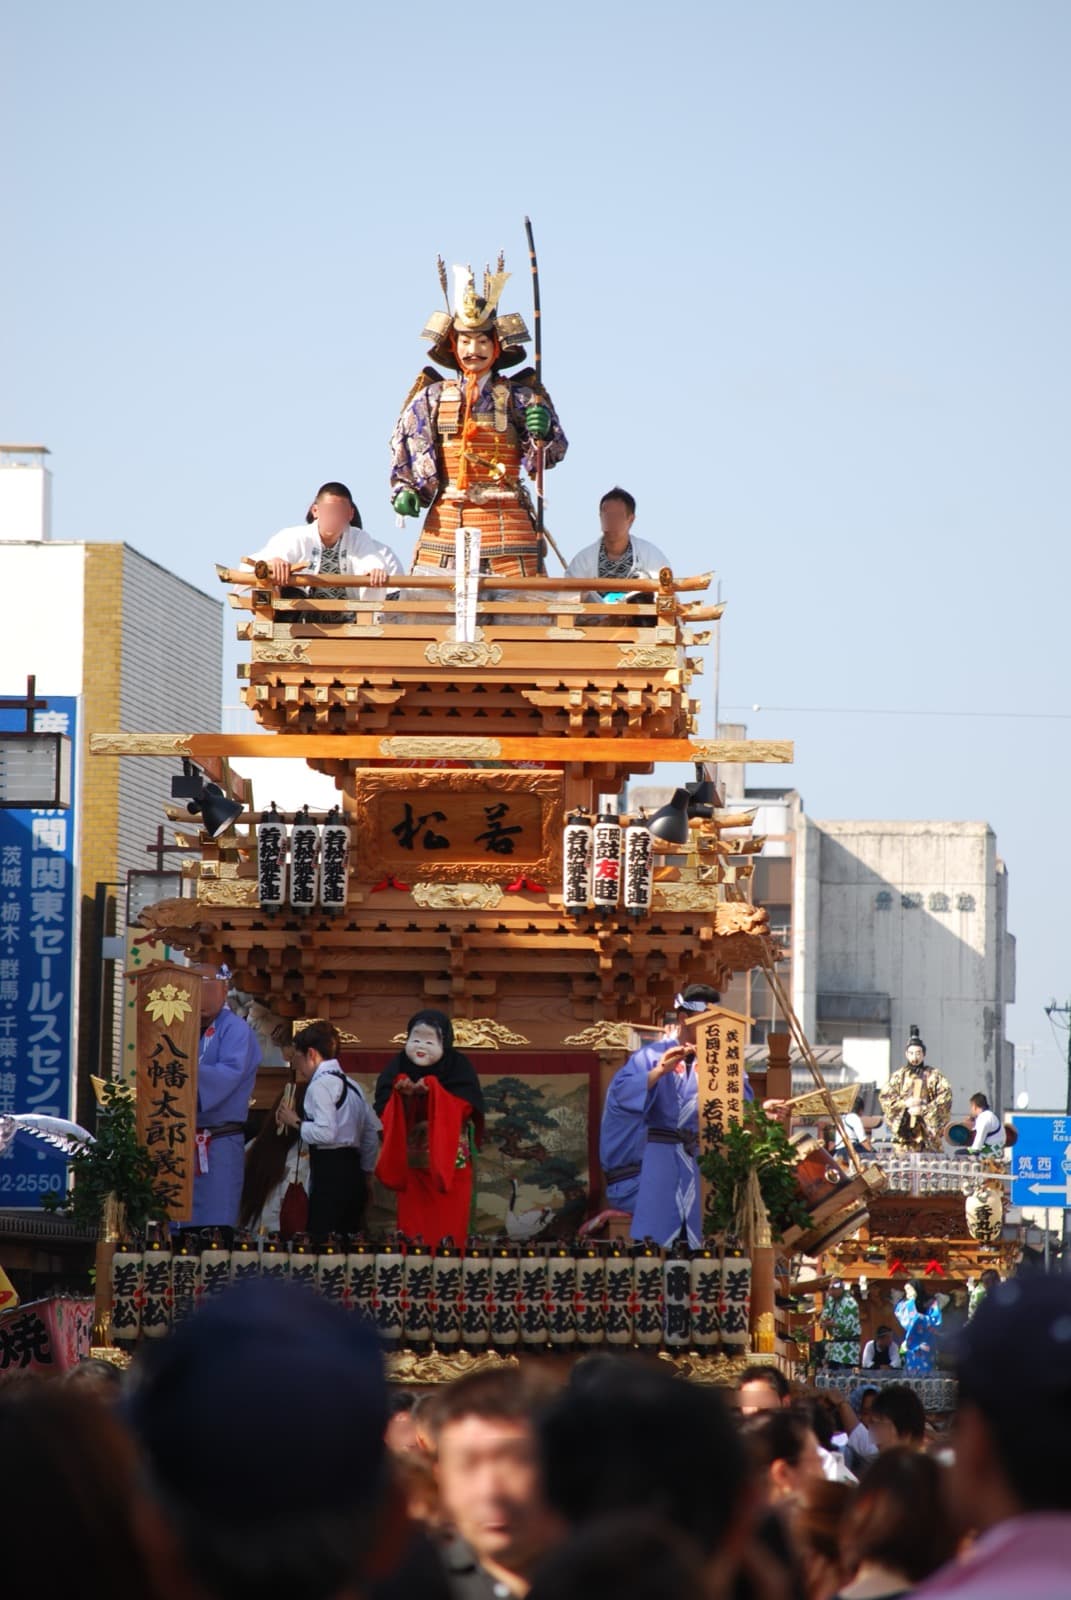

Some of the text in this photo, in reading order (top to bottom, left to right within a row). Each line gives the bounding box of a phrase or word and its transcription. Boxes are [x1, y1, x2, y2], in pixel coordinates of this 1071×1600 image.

[393, 803, 522, 855] 若松
[704, 1023, 721, 1092] 石岡はやし
[146, 1033, 189, 1209] 八幡太郎義家
[1018, 1156, 1053, 1171] 筑西
[973, 1204, 993, 1241] 香丸町
[112, 1261, 139, 1328] 若松
[141, 1260, 169, 1328] 若松
[405, 1266, 433, 1331] 若松
[433, 1268, 460, 1333] 若松
[462, 1268, 488, 1333] 若松
[490, 1267, 518, 1333] 若松
[520, 1267, 547, 1334] 若松
[549, 1267, 576, 1334] 若松
[577, 1267, 604, 1334] 若松
[605, 1267, 632, 1333] 若松
[634, 1267, 662, 1333] 若松
[692, 1269, 720, 1335] 若松
[722, 1268, 749, 1334] 若松
